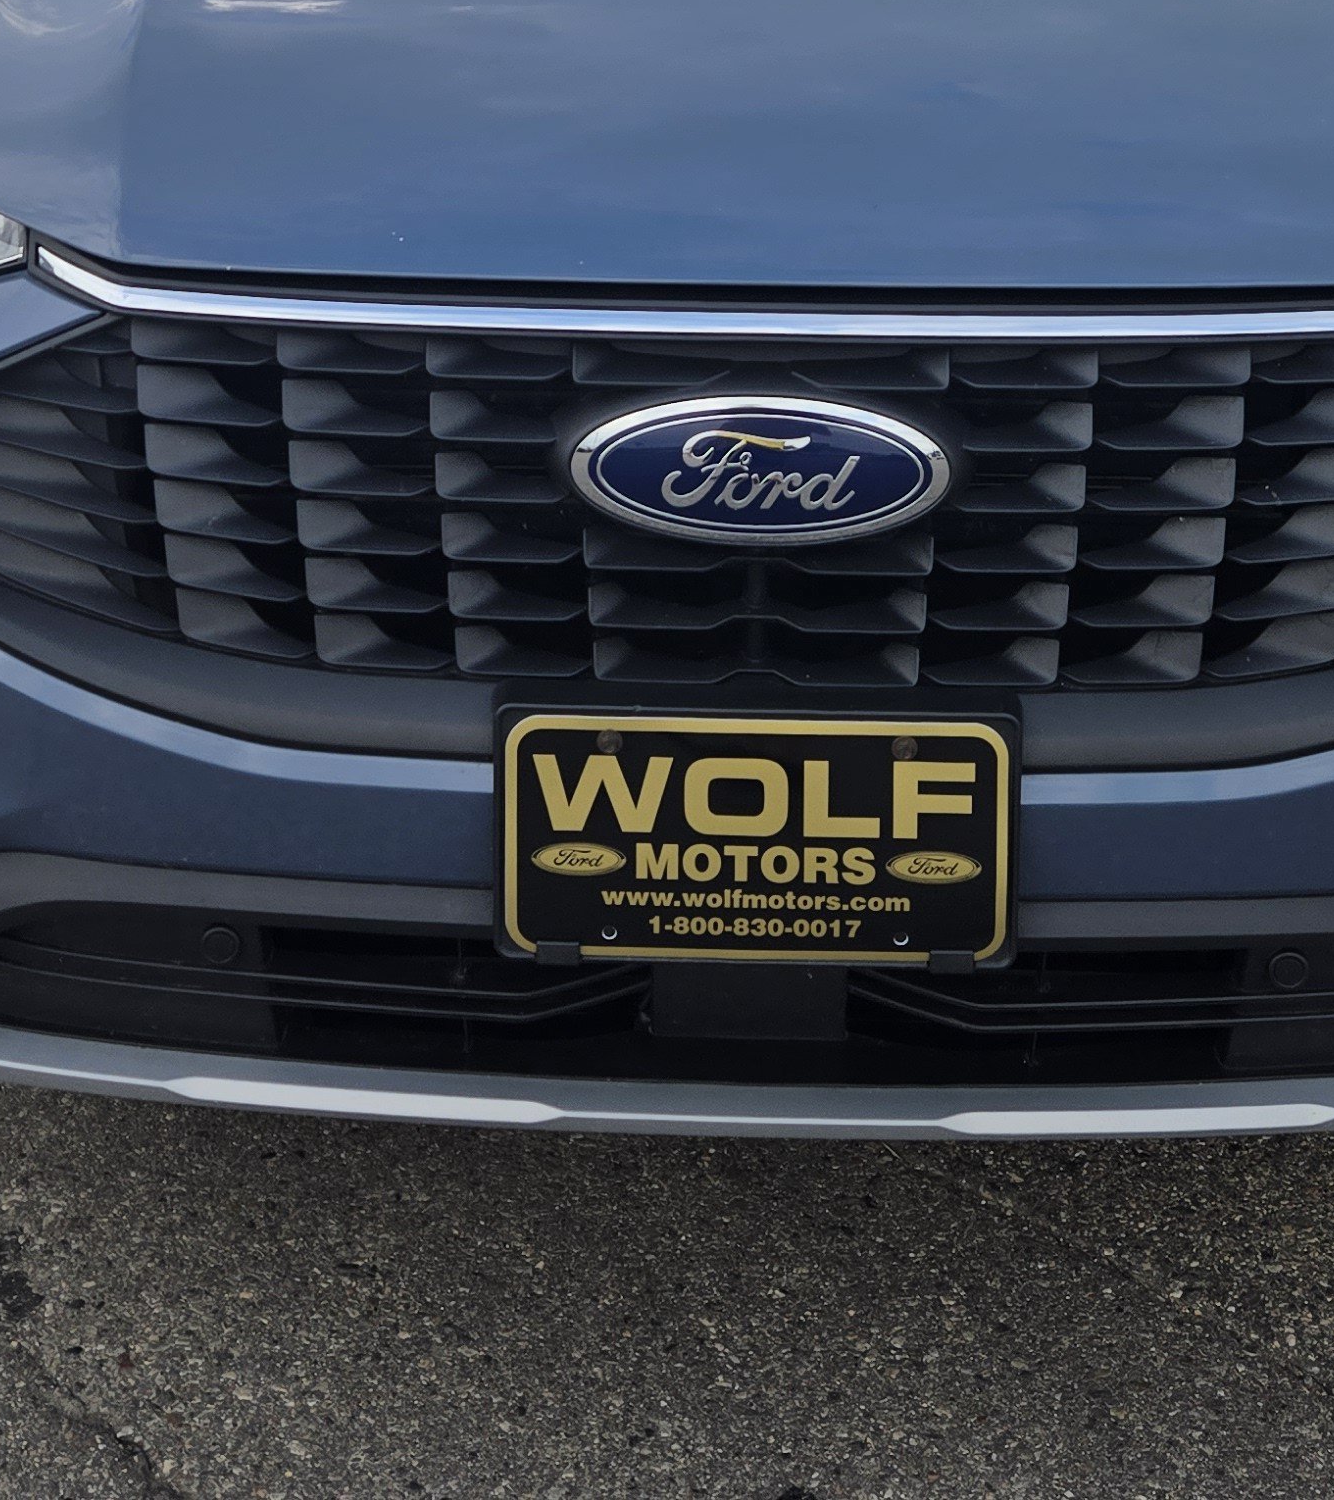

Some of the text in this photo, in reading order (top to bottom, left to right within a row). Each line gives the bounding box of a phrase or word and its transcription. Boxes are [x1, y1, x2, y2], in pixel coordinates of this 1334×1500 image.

[660, 428, 861, 511] Ford
[532, 753, 976, 840] WOLF
[634, 842, 877, 885] MOTORS
[601, 887, 910, 913] www.wolfmotors.com
[647, 916, 862, 939] 1-800-830-0017
